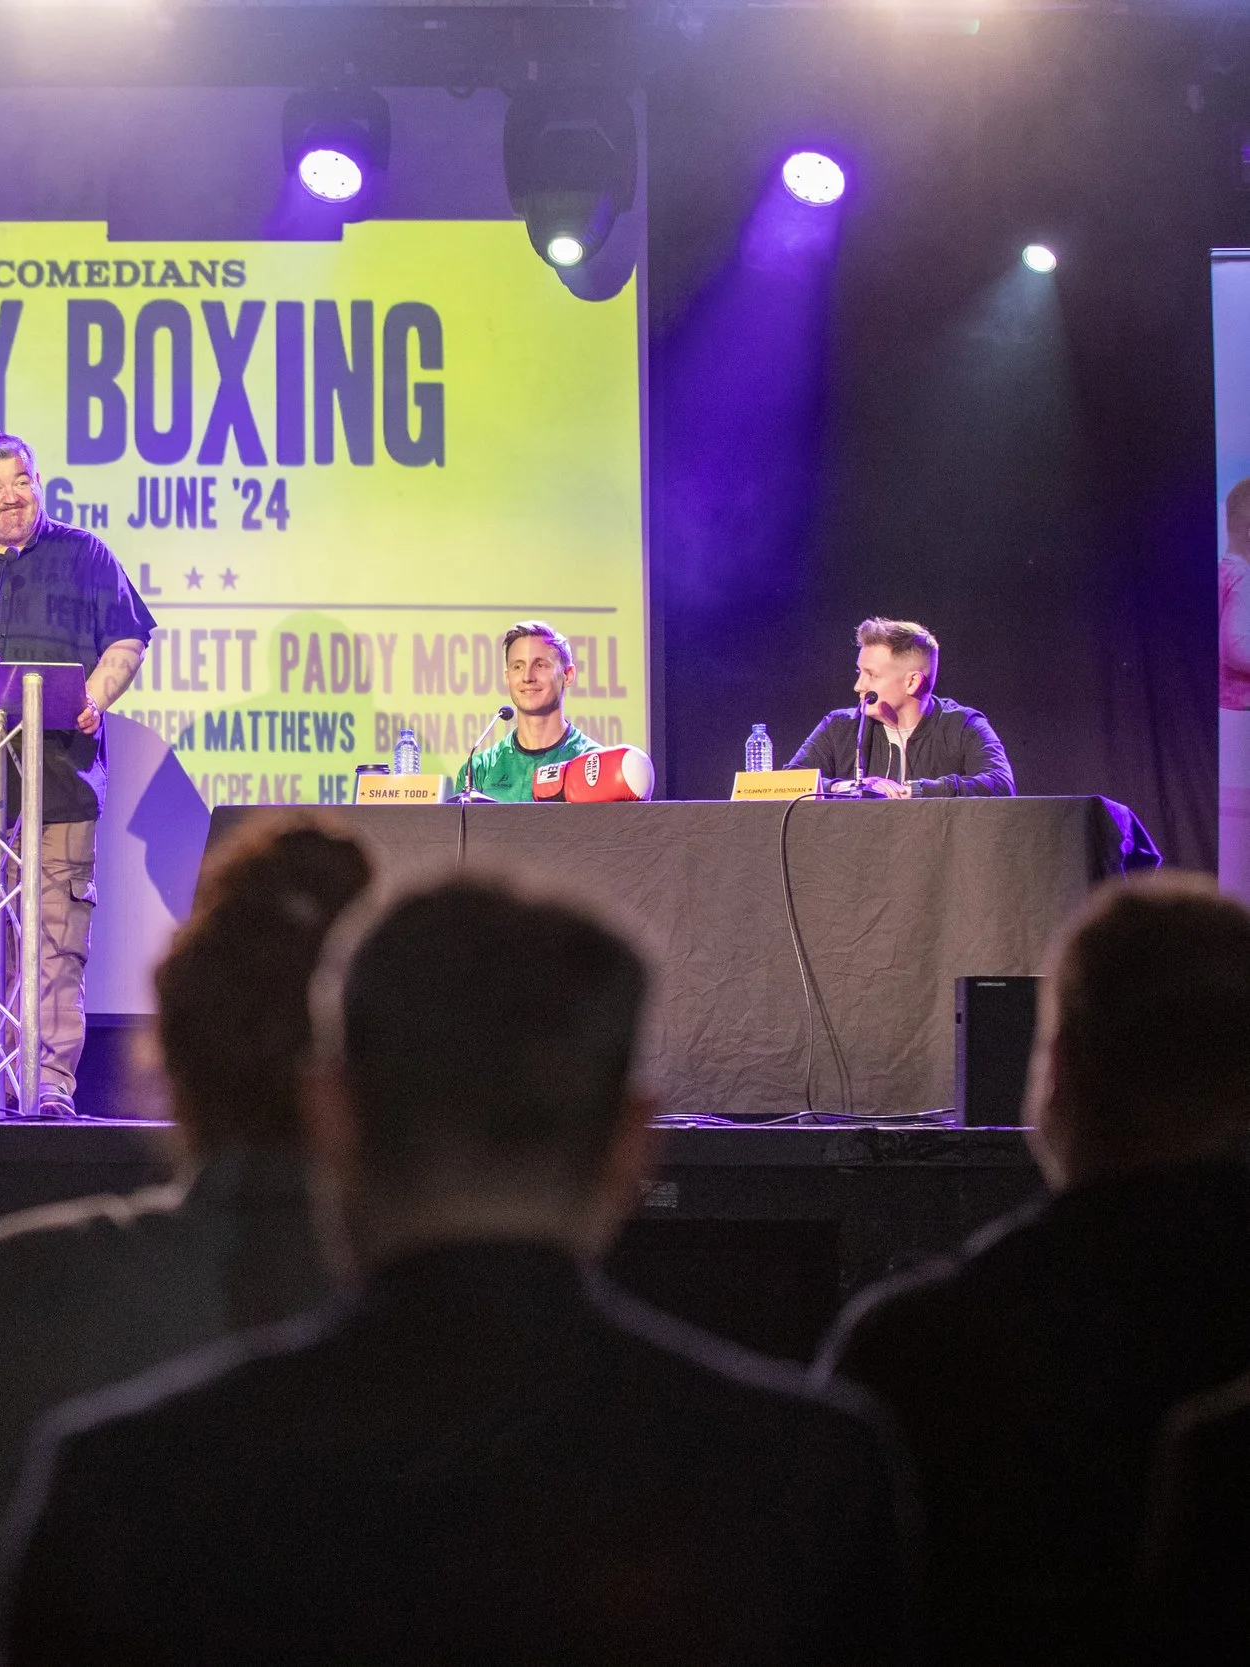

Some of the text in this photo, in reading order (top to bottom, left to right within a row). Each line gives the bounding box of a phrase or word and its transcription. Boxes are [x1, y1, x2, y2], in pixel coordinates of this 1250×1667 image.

[66, 298, 446, 468] BOXING
[45, 477, 108, 530] 6TH
[127, 476, 217, 530] JUNE
[233, 476, 290, 532] '24
[280, 631, 398, 695] PADDY
[204, 710, 356, 754] MATTHEWS
[369, 789, 428, 799] SHANE TODD
